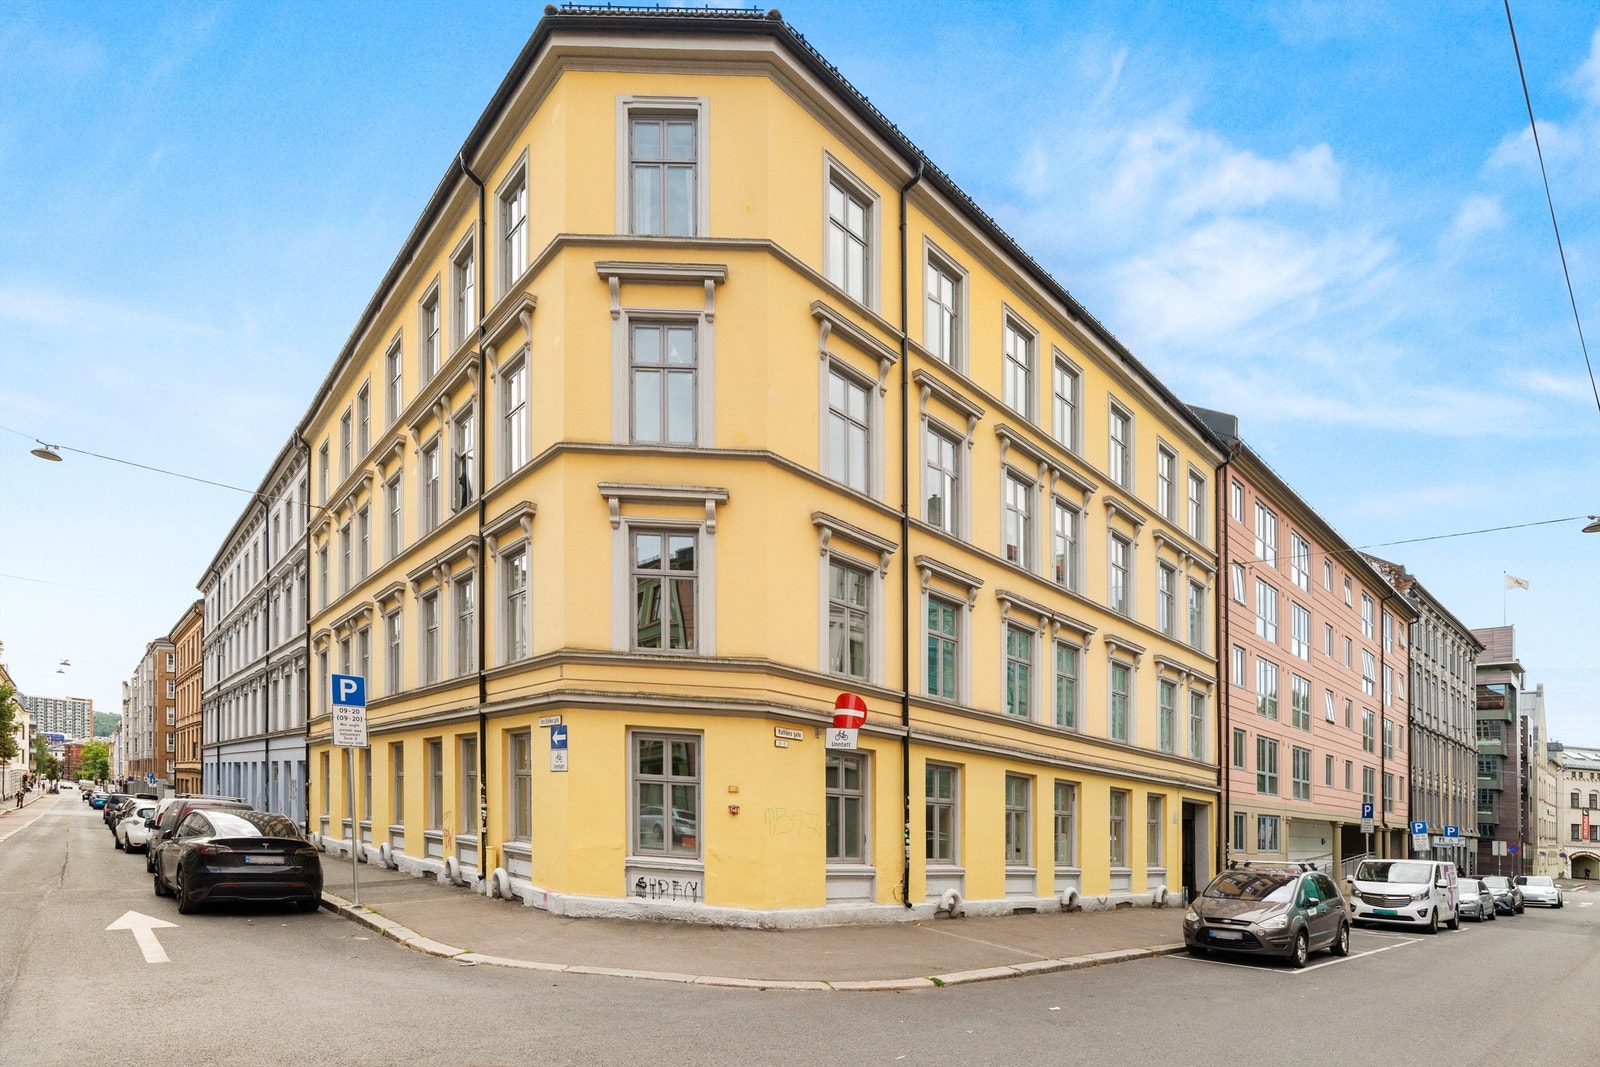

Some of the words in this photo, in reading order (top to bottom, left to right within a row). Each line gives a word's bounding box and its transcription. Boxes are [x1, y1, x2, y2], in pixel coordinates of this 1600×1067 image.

[340, 679, 357, 701] P
[1364, 805, 1371, 816] P
[1415, 823, 1423, 832] P
[1447, 827, 1455, 835] P
